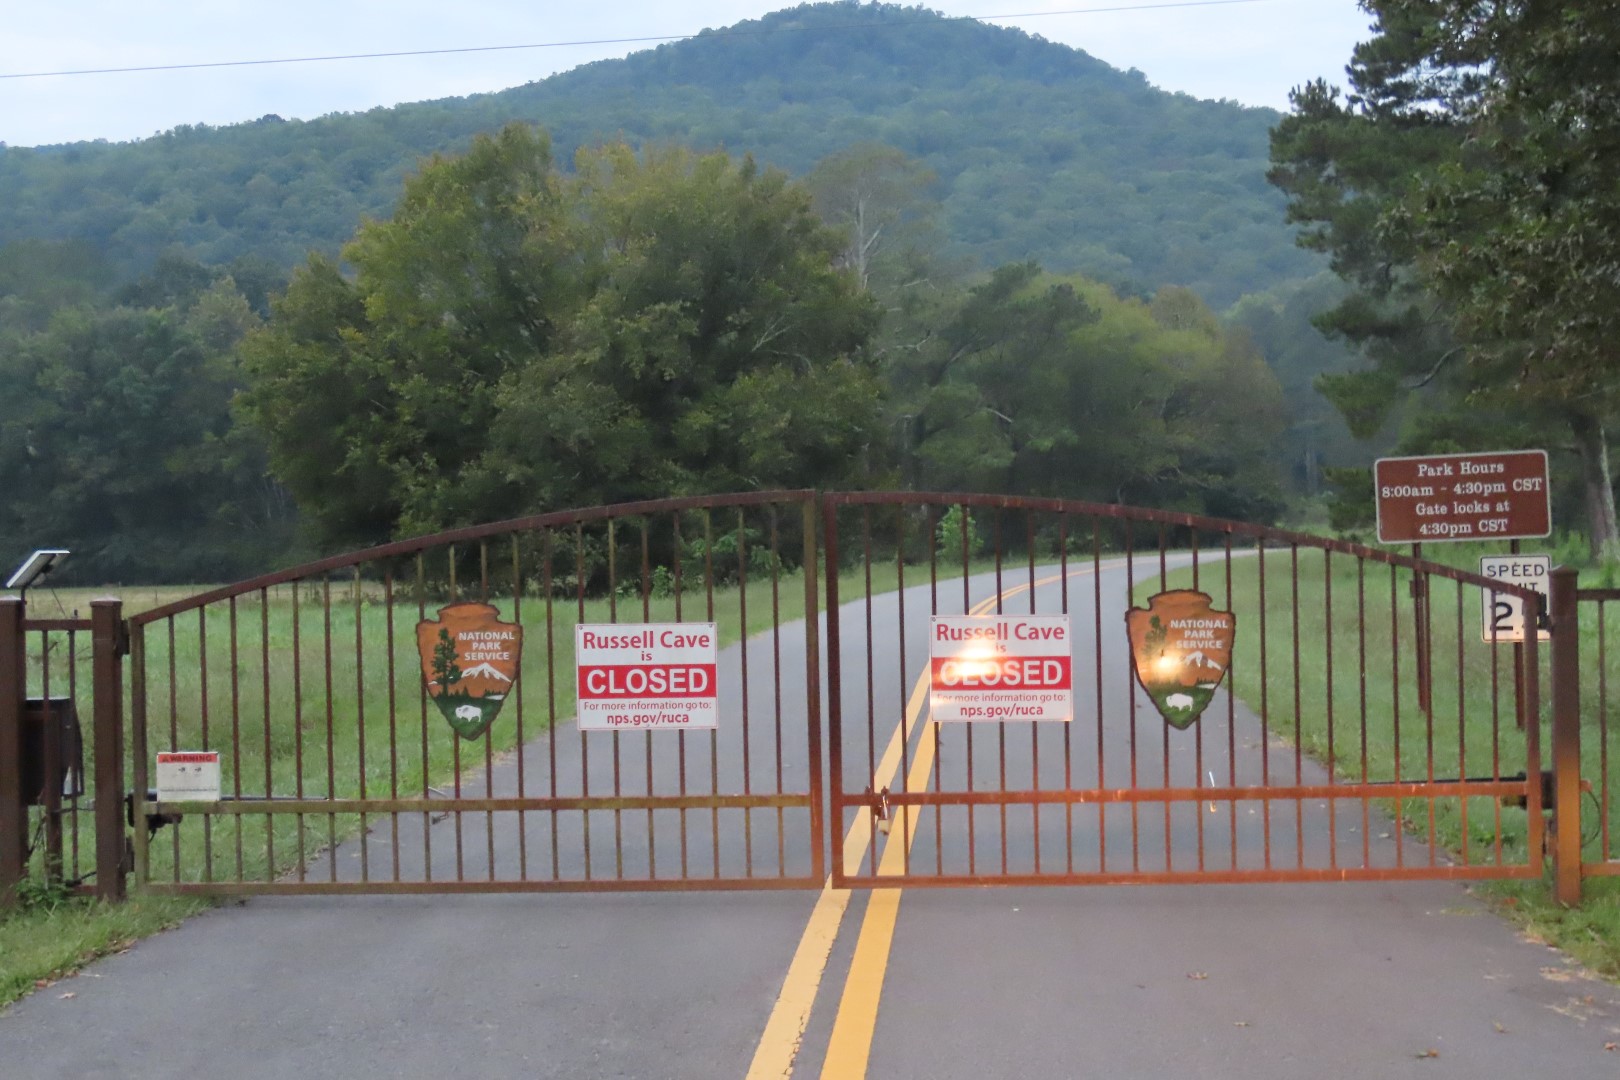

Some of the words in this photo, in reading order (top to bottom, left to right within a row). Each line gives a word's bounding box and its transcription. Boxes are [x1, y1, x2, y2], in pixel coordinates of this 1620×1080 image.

[1418, 464, 1453, 476] Park
[1460, 462, 1504, 474] Hours
[1382, 485, 1433, 498] 8:00am
[1454, 482, 1506, 496] 4:30pm
[1513, 478, 1542, 491] CST
[1416, 503, 1447, 515] Gate
[1454, 501, 1490, 514] locks
[1496, 501, 1510, 512] at
[1420, 522, 1472, 537] 4:30pm
[1478, 519, 1508, 532] CST
[1487, 565, 1544, 577] SPEED
[1170, 620, 1228, 628] NATIONAL
[459, 632, 514, 640] NATIONAL
[936, 623, 1008, 641] Russell
[1015, 623, 1064, 640] Cave
[1184, 630, 1214, 638] PARK
[472, 642, 500, 650] PARK
[584, 631, 653, 649] Russell
[660, 631, 709, 648] Cave
[1176, 640, 1223, 648] SERVICE
[995, 643, 1006, 652] is
[464, 652, 509, 660] SERVICE
[641, 651, 652, 661] is
[940, 660, 1063, 686] CLOSED
[587, 669, 708, 694] CLOSED
[982, 693, 1037, 702] information
[1040, 694, 1052, 703] go
[584, 702, 598, 710] For
[628, 702, 683, 710] information
[686, 703, 698, 711] go
[960, 703, 1043, 717] nps.gov/ruca
[607, 711, 689, 725] nps.gov/ruca
